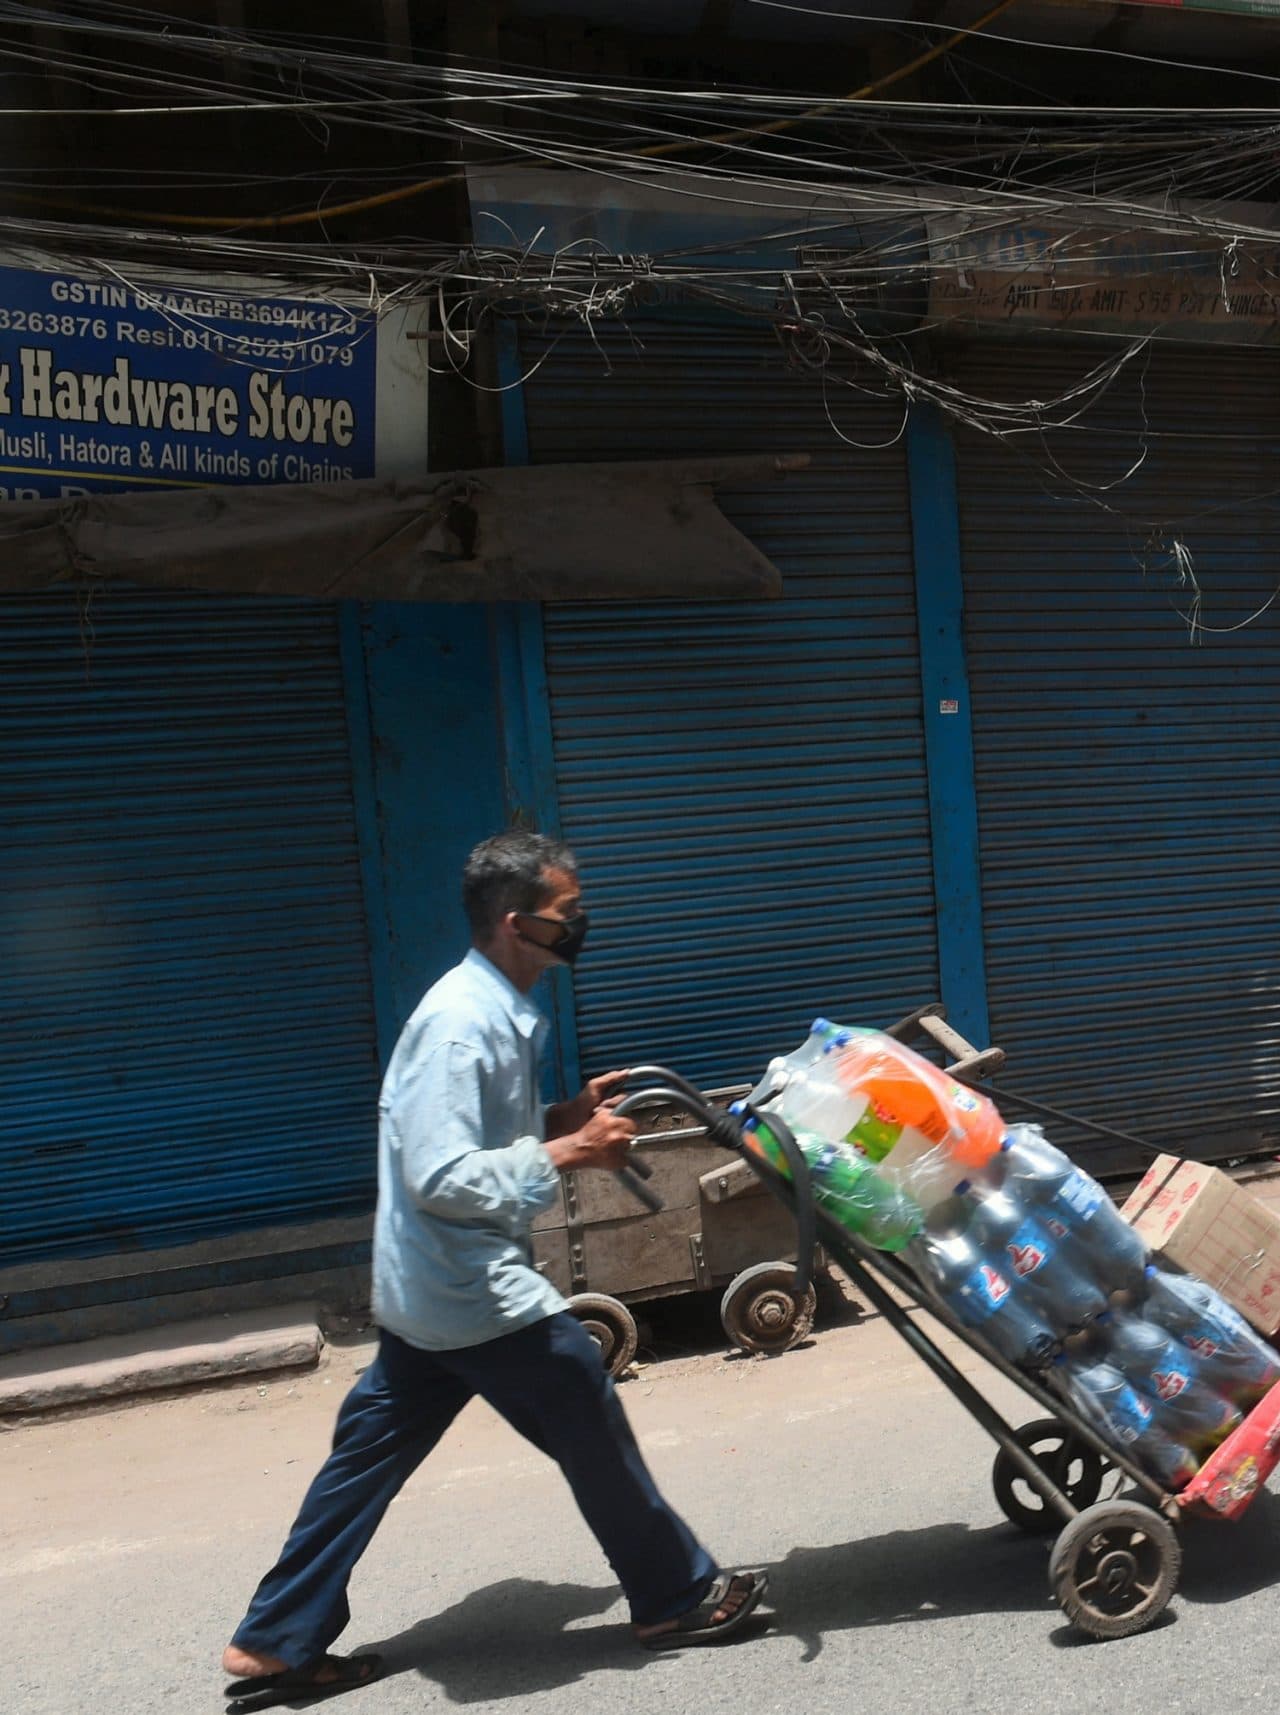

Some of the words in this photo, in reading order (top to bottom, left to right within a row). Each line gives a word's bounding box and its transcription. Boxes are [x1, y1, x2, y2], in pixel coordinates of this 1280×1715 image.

[50, 279, 128, 310] GSTIN
[19, 347, 239, 437] Hardware
[248, 370, 355, 448] Store
[59, 432, 132, 467] Hatora
[138, 441, 155, 470] &
[160, 443, 188, 473] All
[194, 446, 251, 479] kinds
[257, 450, 279, 480] of
[284, 452, 354, 484] Chains
